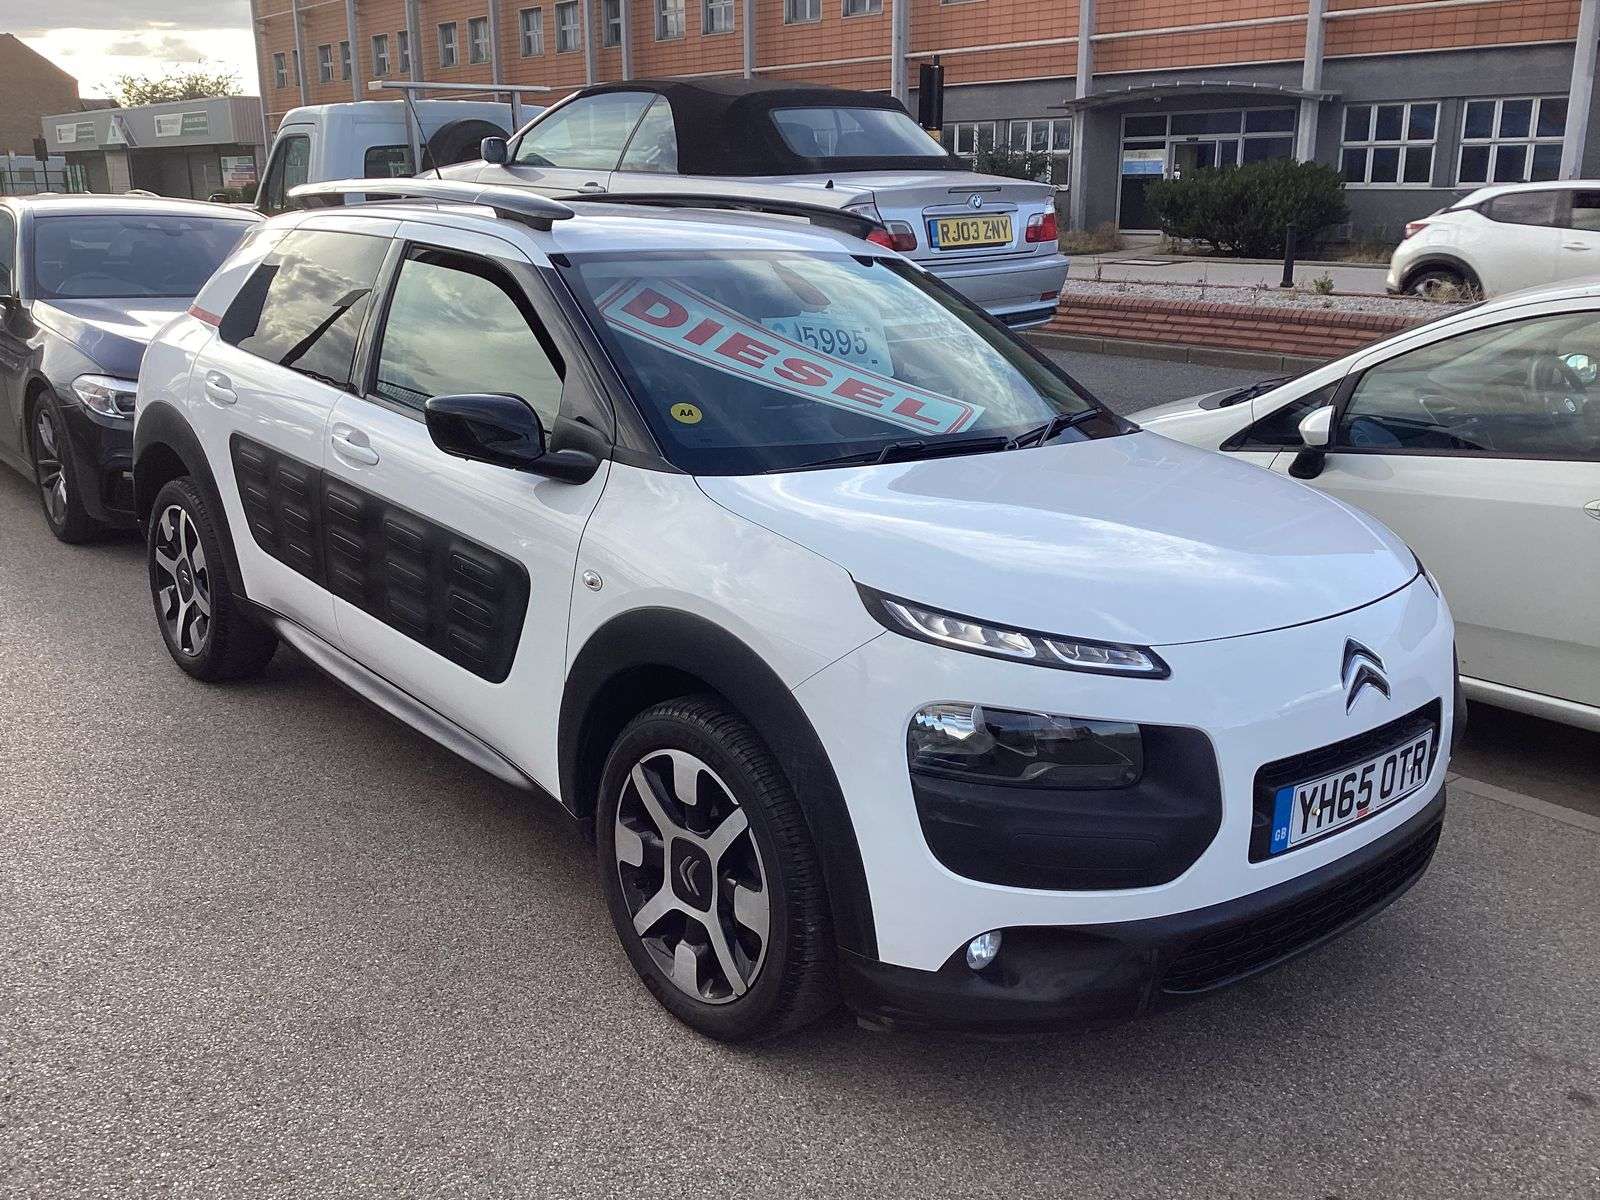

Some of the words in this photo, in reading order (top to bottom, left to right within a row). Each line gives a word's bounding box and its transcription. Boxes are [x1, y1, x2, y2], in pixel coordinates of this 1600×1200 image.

[940, 220, 979, 243] RJ03
[982, 219, 1009, 240] ZNY
[802, 326, 868, 355] 5995
[621, 287, 941, 426] DIESEL
[679, 409, 694, 417] AA
[1299, 763, 1376, 835] YH65
[1379, 739, 1428, 800] OTR
[1274, 827, 1287, 842] GB
